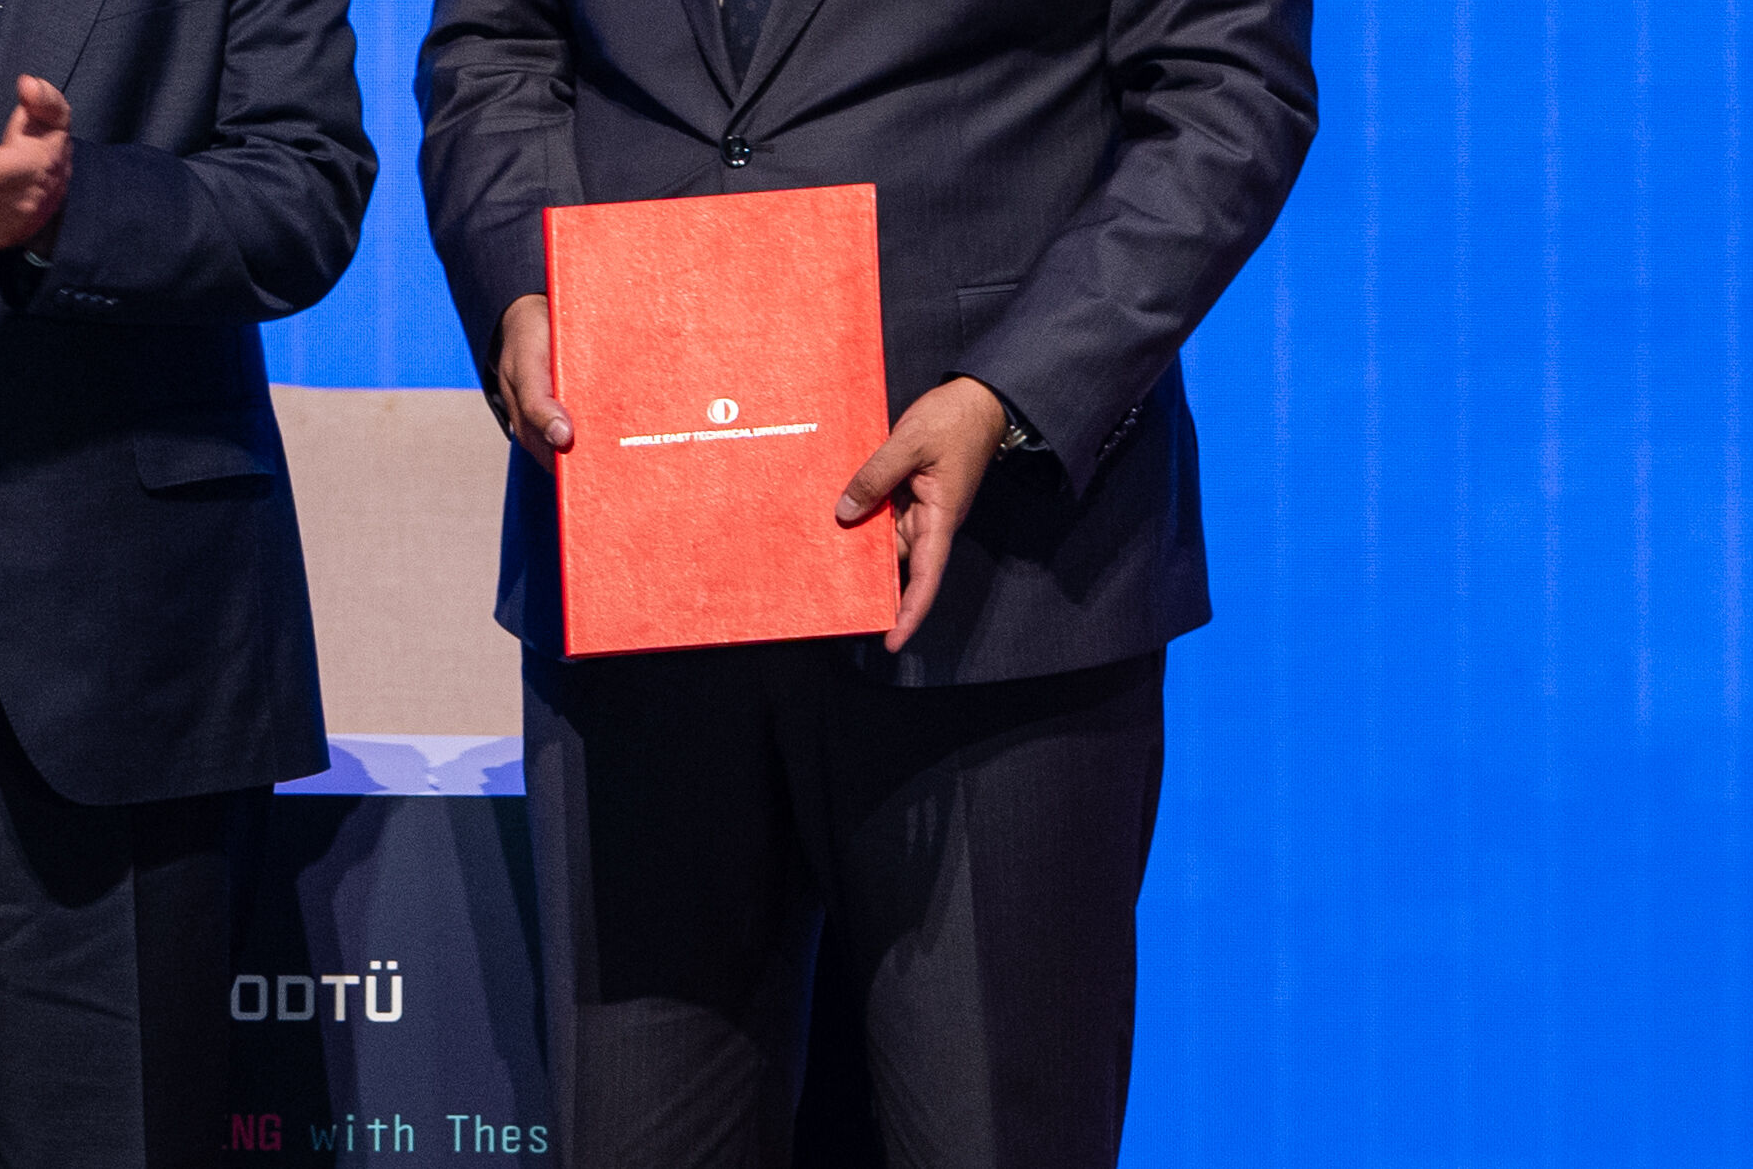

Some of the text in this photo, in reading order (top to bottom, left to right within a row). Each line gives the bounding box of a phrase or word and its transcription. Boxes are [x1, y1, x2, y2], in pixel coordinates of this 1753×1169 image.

[619, 422, 818, 447] MIDDLE EAST TECHNICAL UNIVERSITY
[229, 959, 404, 1023] ODTÜ
[310, 1113, 415, 1154] with
[445, 1113, 549, 1154] Thes
